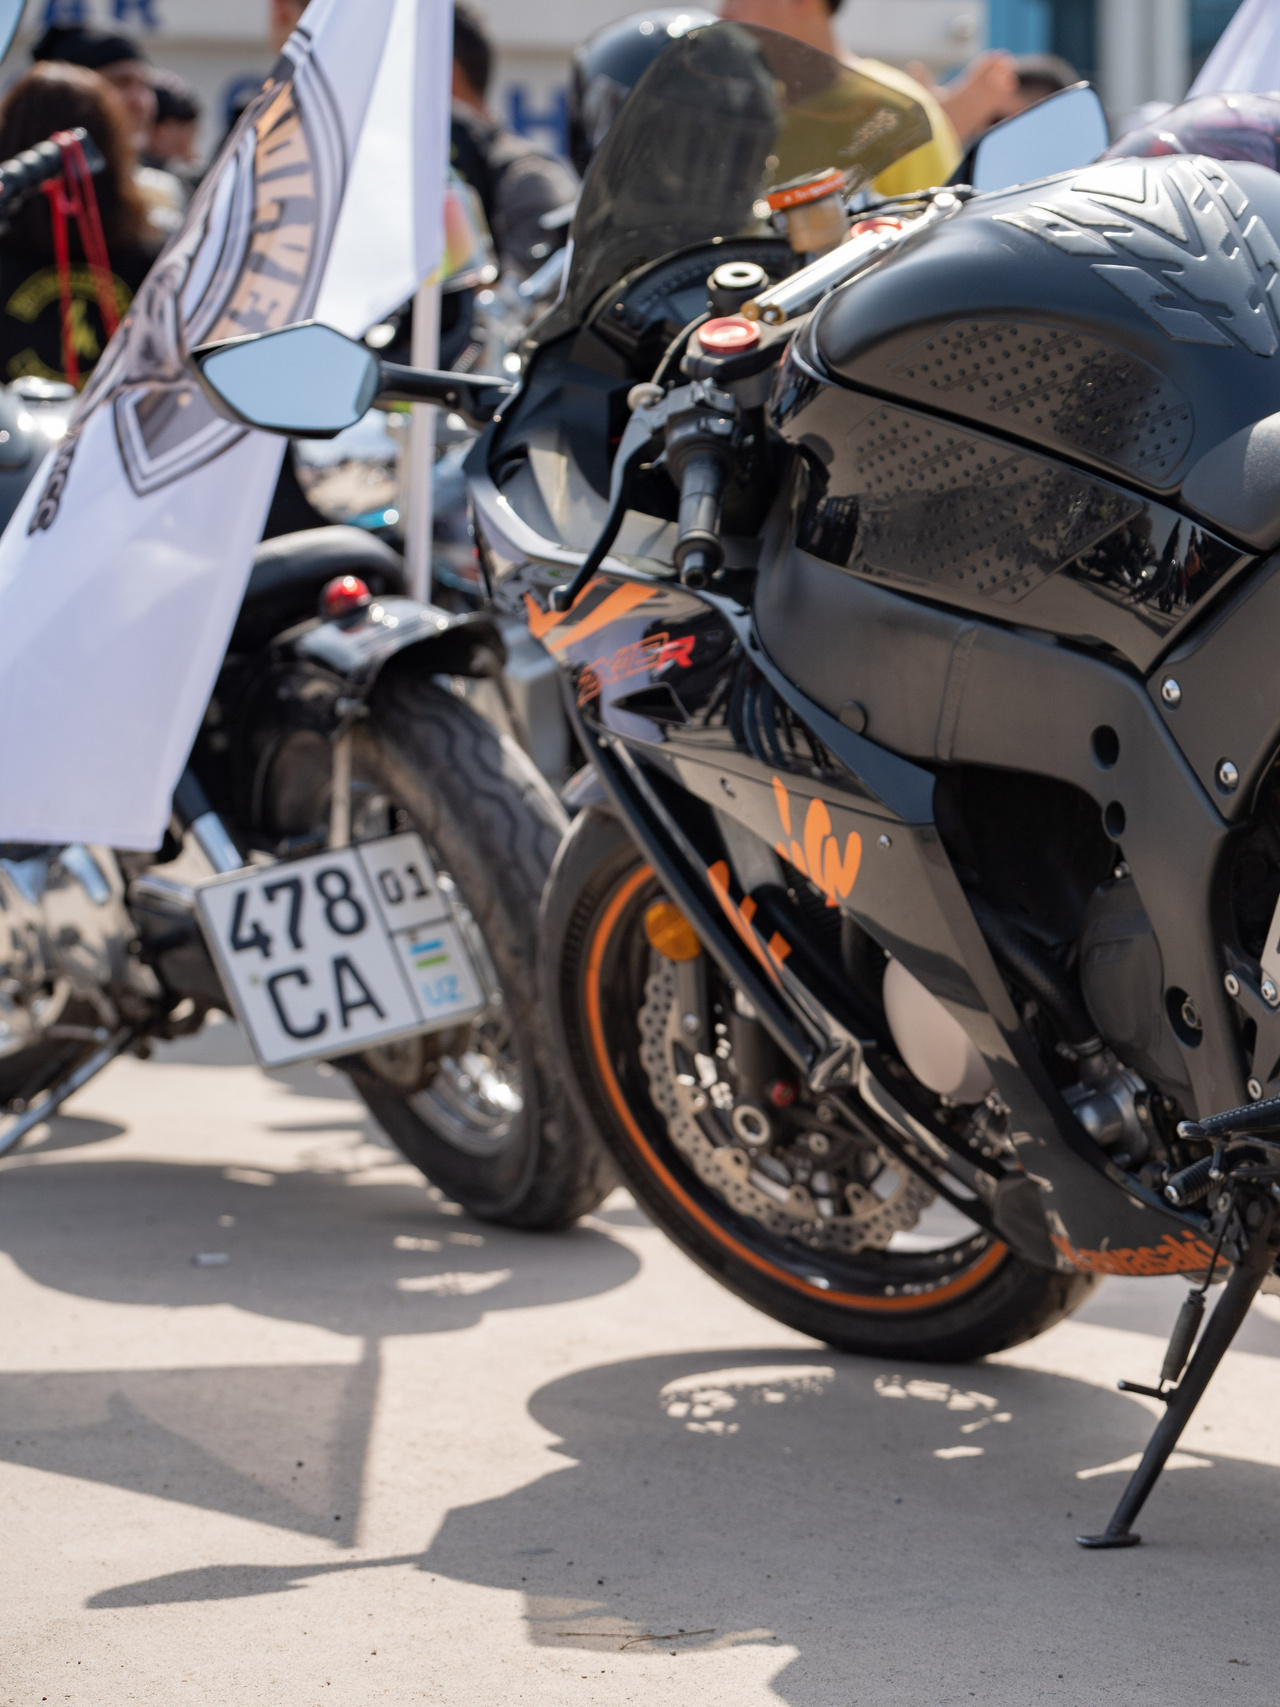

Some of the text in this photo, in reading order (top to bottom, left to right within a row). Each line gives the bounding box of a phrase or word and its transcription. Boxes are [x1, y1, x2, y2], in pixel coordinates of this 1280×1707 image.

[229, 865, 366, 959] 478
[377, 863, 431, 905] 01
[266, 953, 387, 1040] CA
[422, 975, 463, 1007] UZ
